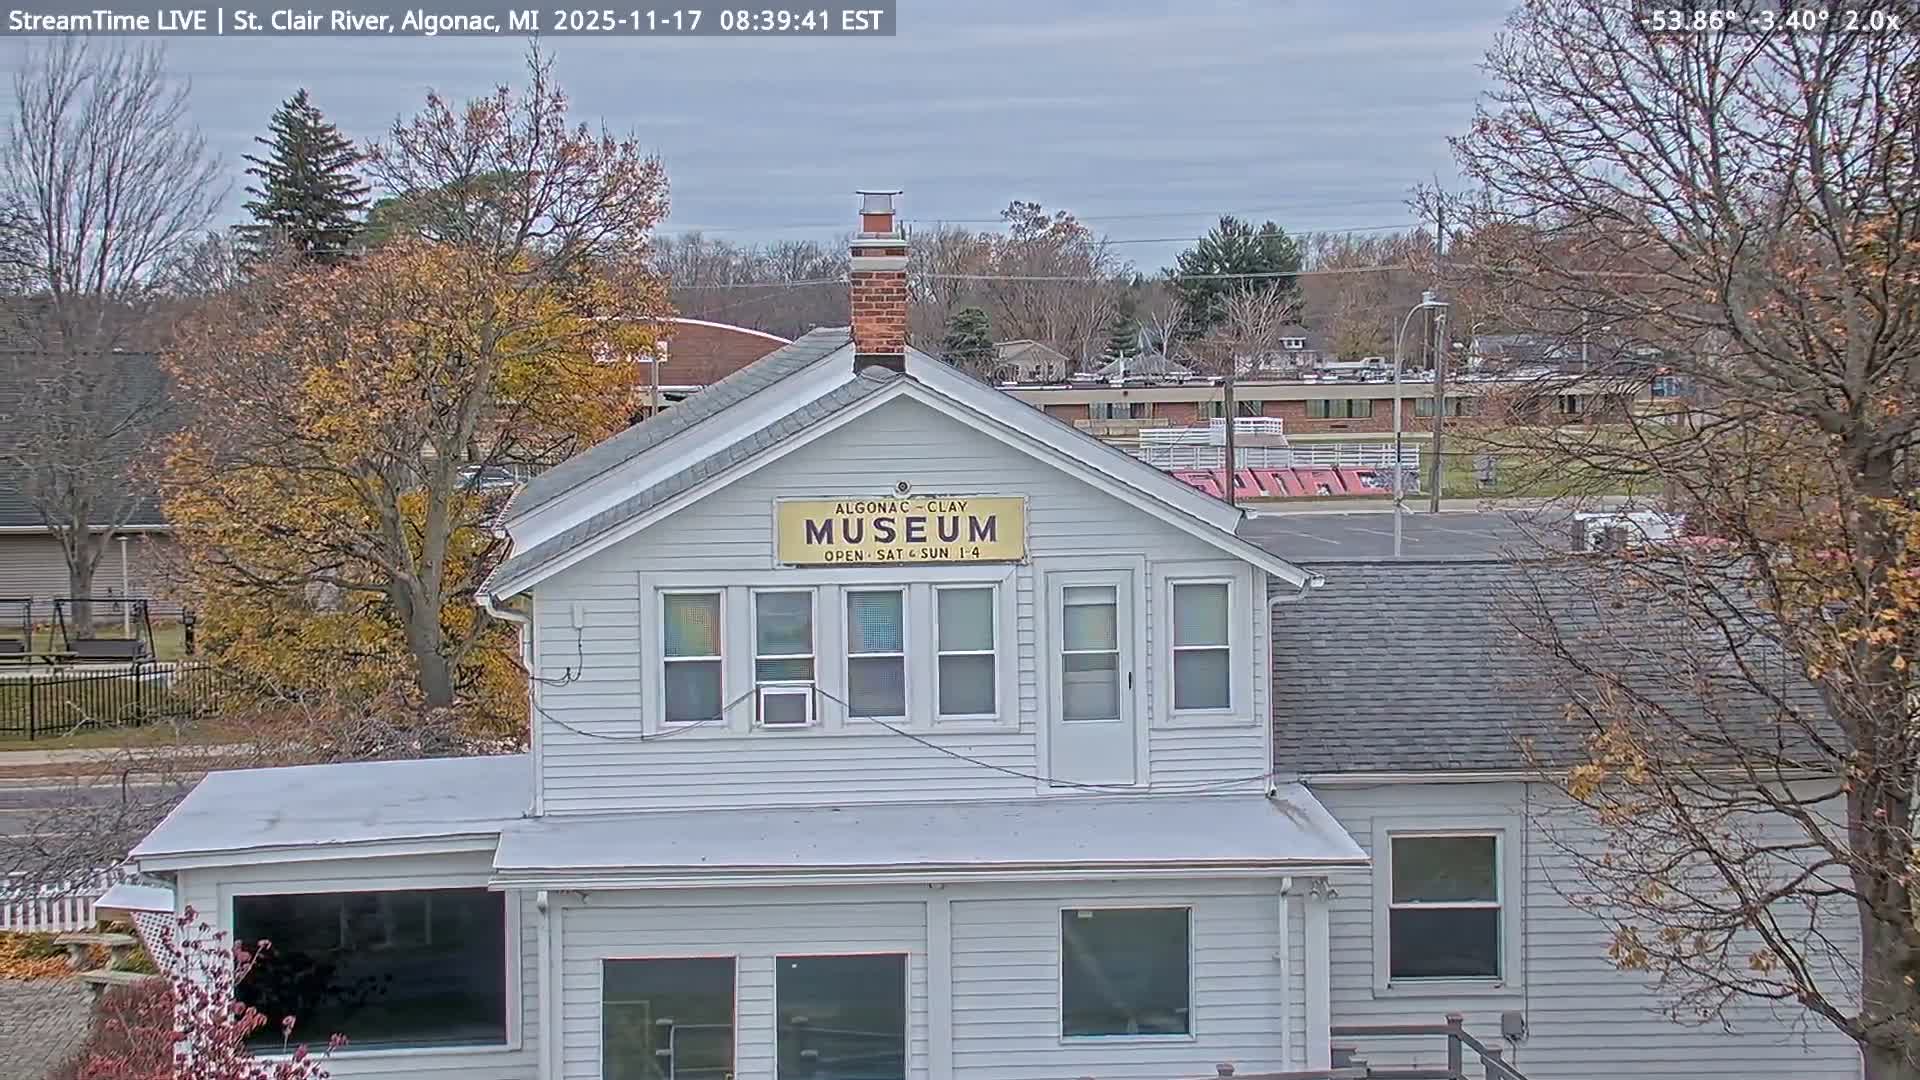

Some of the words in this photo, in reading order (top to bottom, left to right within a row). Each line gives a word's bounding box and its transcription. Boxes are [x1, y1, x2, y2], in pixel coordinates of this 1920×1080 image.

[835, 501, 910, 515] ALGONAC
[926, 500, 968, 514] CLAY
[805, 515, 998, 545] MUSEUM
[824, 549, 864, 562] OPEN
[876, 548, 904, 561] SAT
[920, 547, 949, 560] SUN
[960, 546, 981, 559] 1-4
